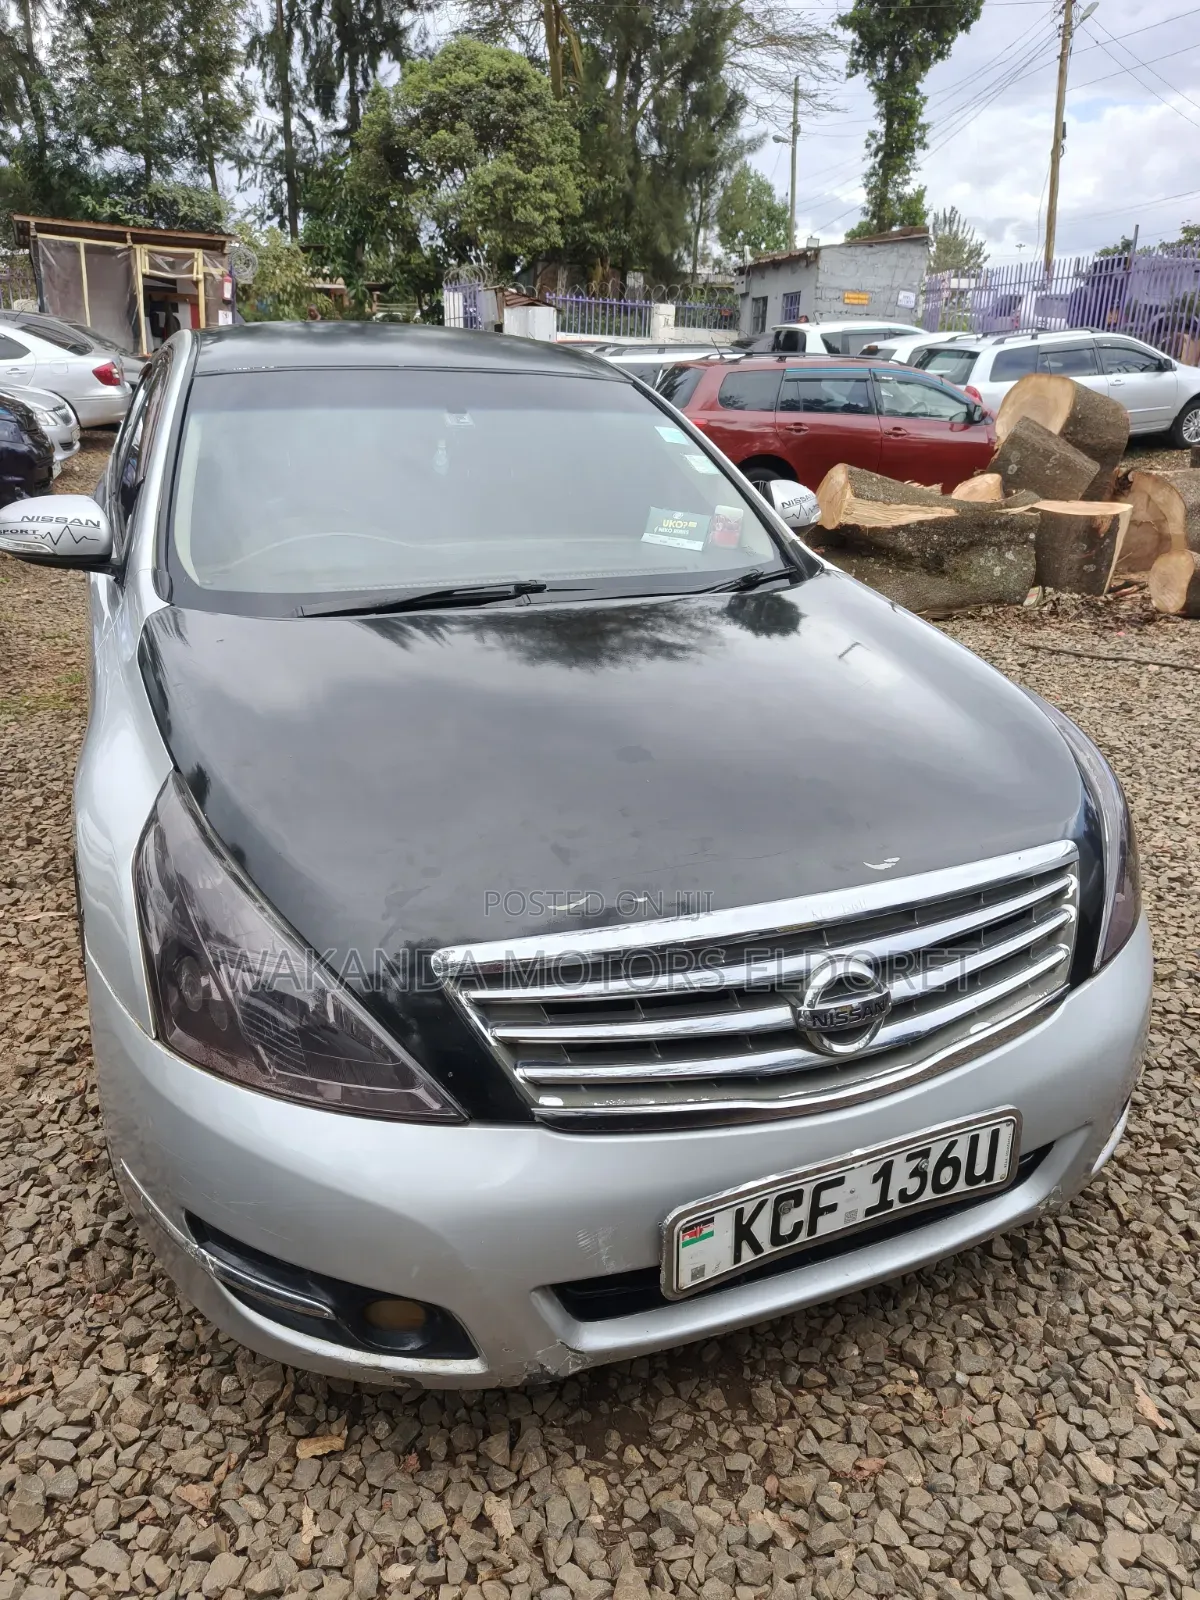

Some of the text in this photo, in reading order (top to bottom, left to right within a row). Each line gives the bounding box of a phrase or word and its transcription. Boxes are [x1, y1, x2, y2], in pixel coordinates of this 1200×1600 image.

[21, 515, 101, 528] NISSAN
[811, 999, 886, 1027] NISSAN
[733, 1127, 1001, 1266] KCF 136U
